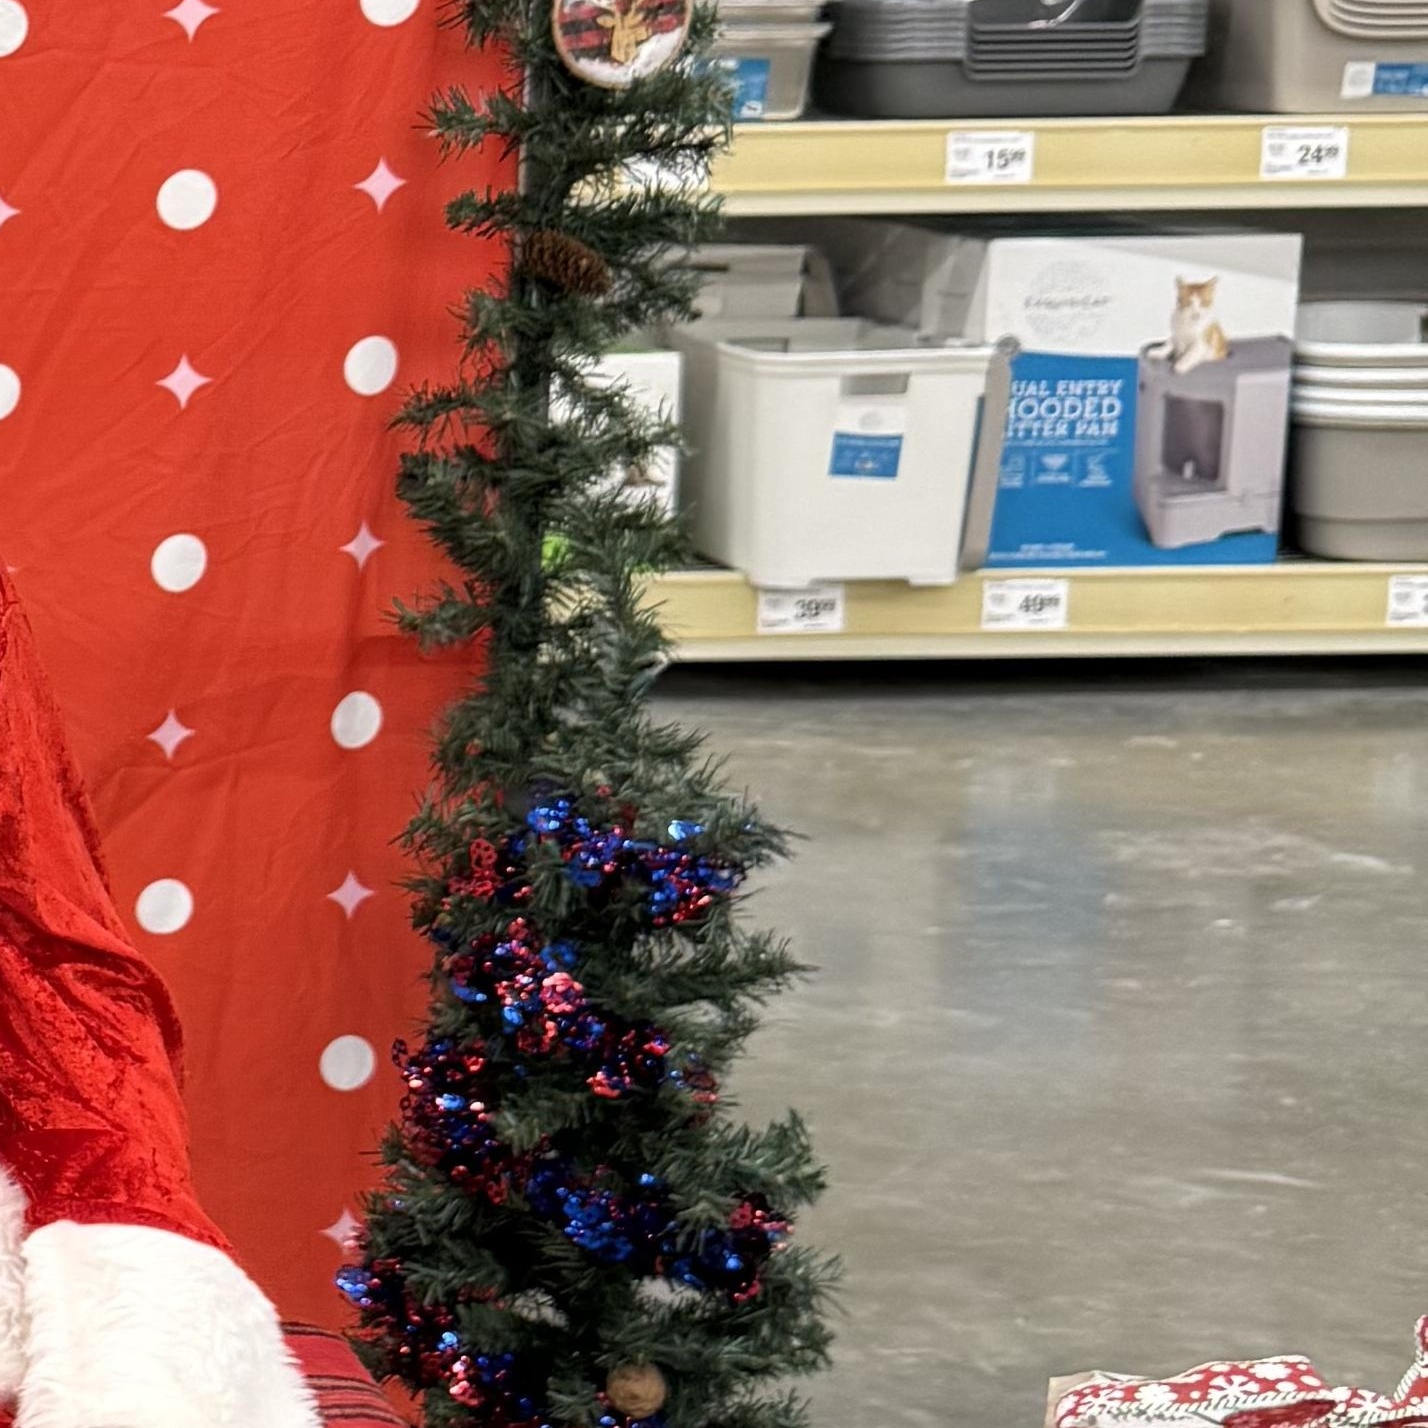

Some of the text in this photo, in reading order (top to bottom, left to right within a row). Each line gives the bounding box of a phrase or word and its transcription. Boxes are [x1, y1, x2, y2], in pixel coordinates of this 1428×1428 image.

[1011, 379, 1123, 397] UAL ENTRY
[1007, 419, 1120, 438] ITTER PAN
